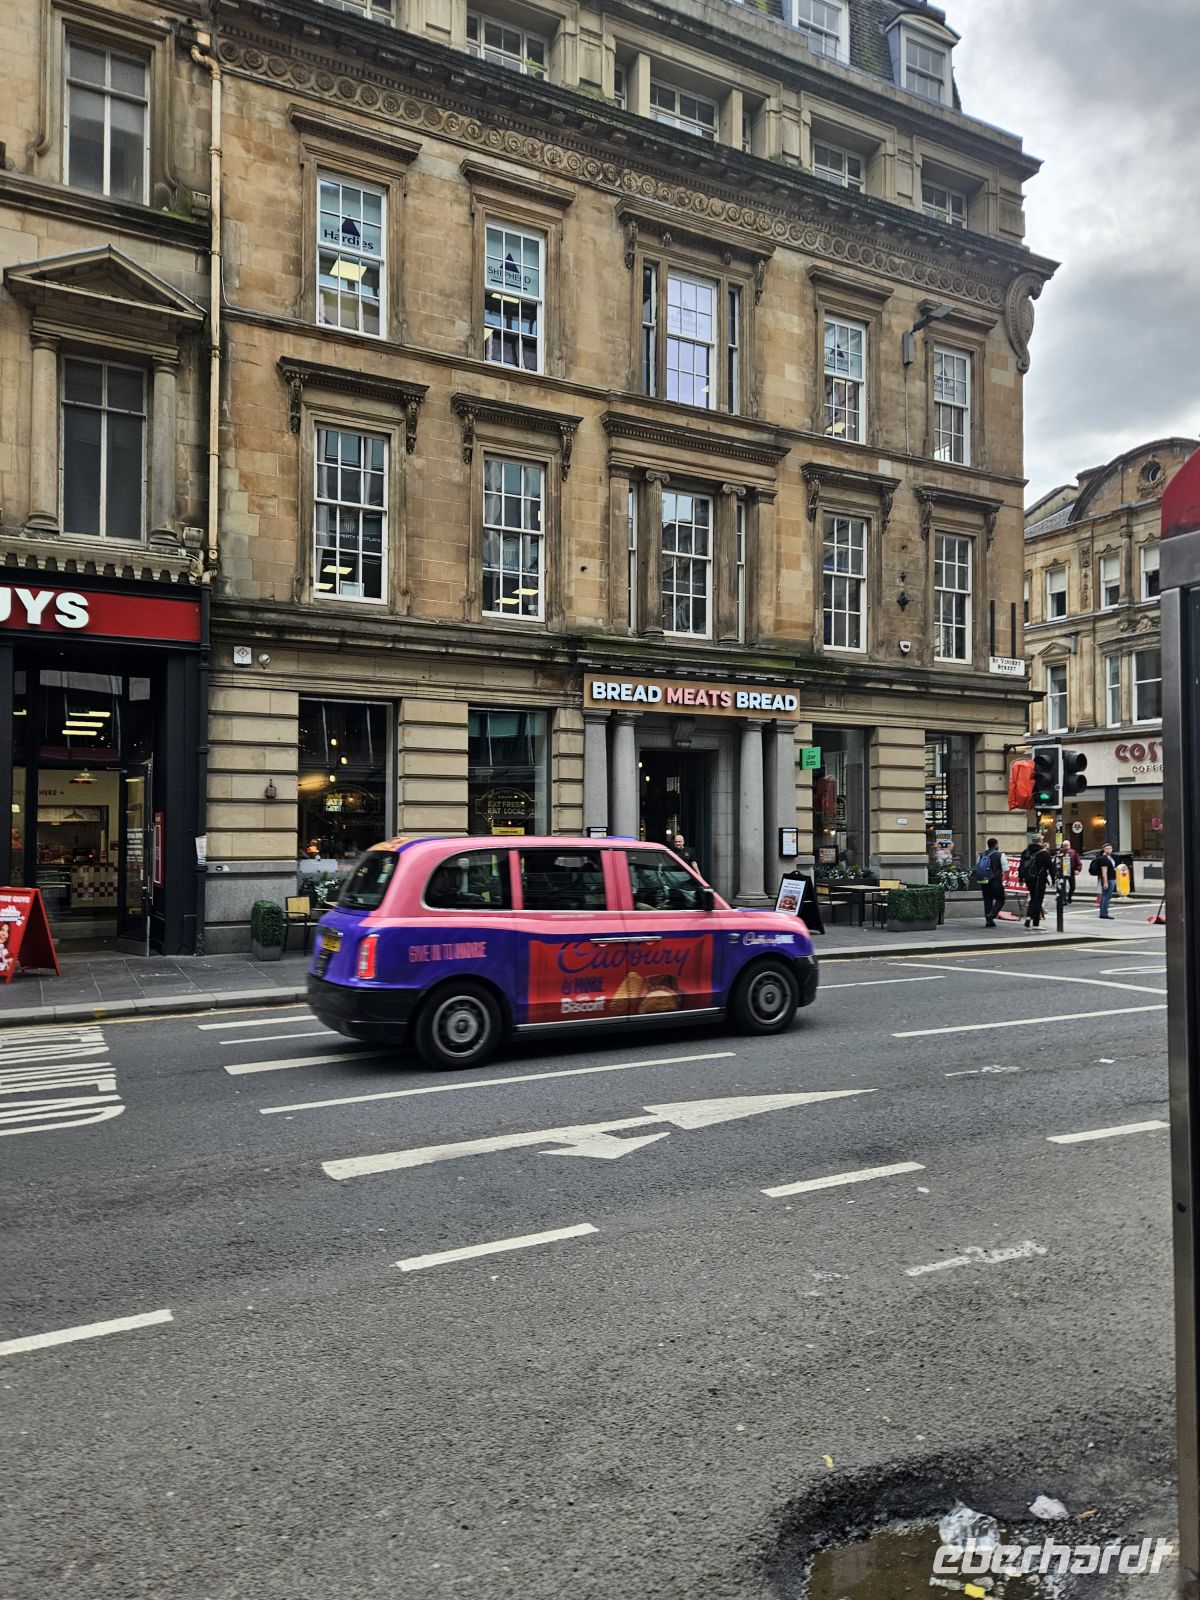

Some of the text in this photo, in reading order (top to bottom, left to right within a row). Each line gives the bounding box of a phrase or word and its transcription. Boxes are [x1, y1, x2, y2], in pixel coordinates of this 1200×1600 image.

[323, 229, 374, 250] Hardies
[592, 681, 798, 711] BREAD MEATS BREAD
[1115, 742, 1163, 763] COS
[557, 941, 689, 977] Cadbury
[560, 995, 606, 1013] Biscoff
